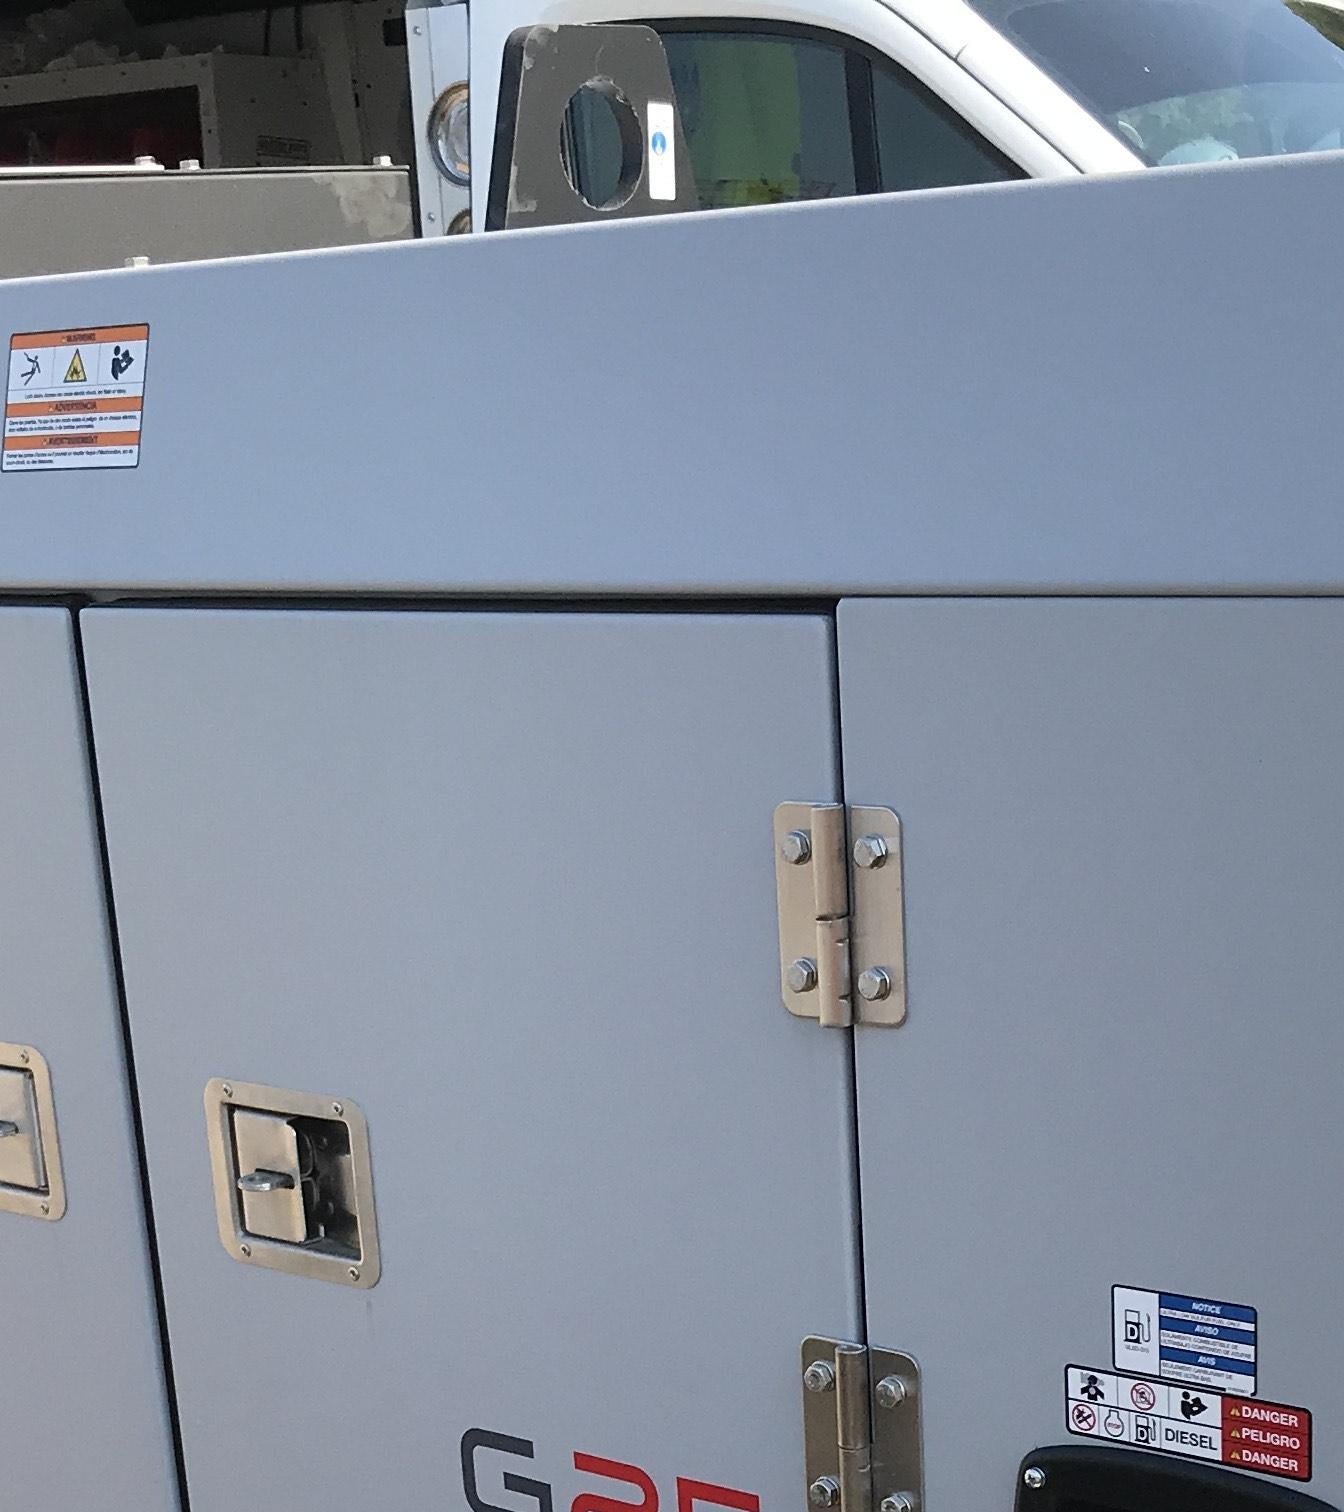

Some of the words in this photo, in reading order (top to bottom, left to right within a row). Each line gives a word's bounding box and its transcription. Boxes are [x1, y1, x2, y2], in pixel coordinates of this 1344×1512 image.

[1192, 1302, 1222, 1314] NOTICE
[1195, 1325, 1219, 1335] AVISO
[1198, 1356, 1216, 1366] AVIS
[1242, 1406, 1298, 1427] DANGER
[1165, 1428, 1218, 1451] DIESEL
[1242, 1427, 1300, 1450] PELIGRO
[1242, 1449, 1299, 1472] DANGER
